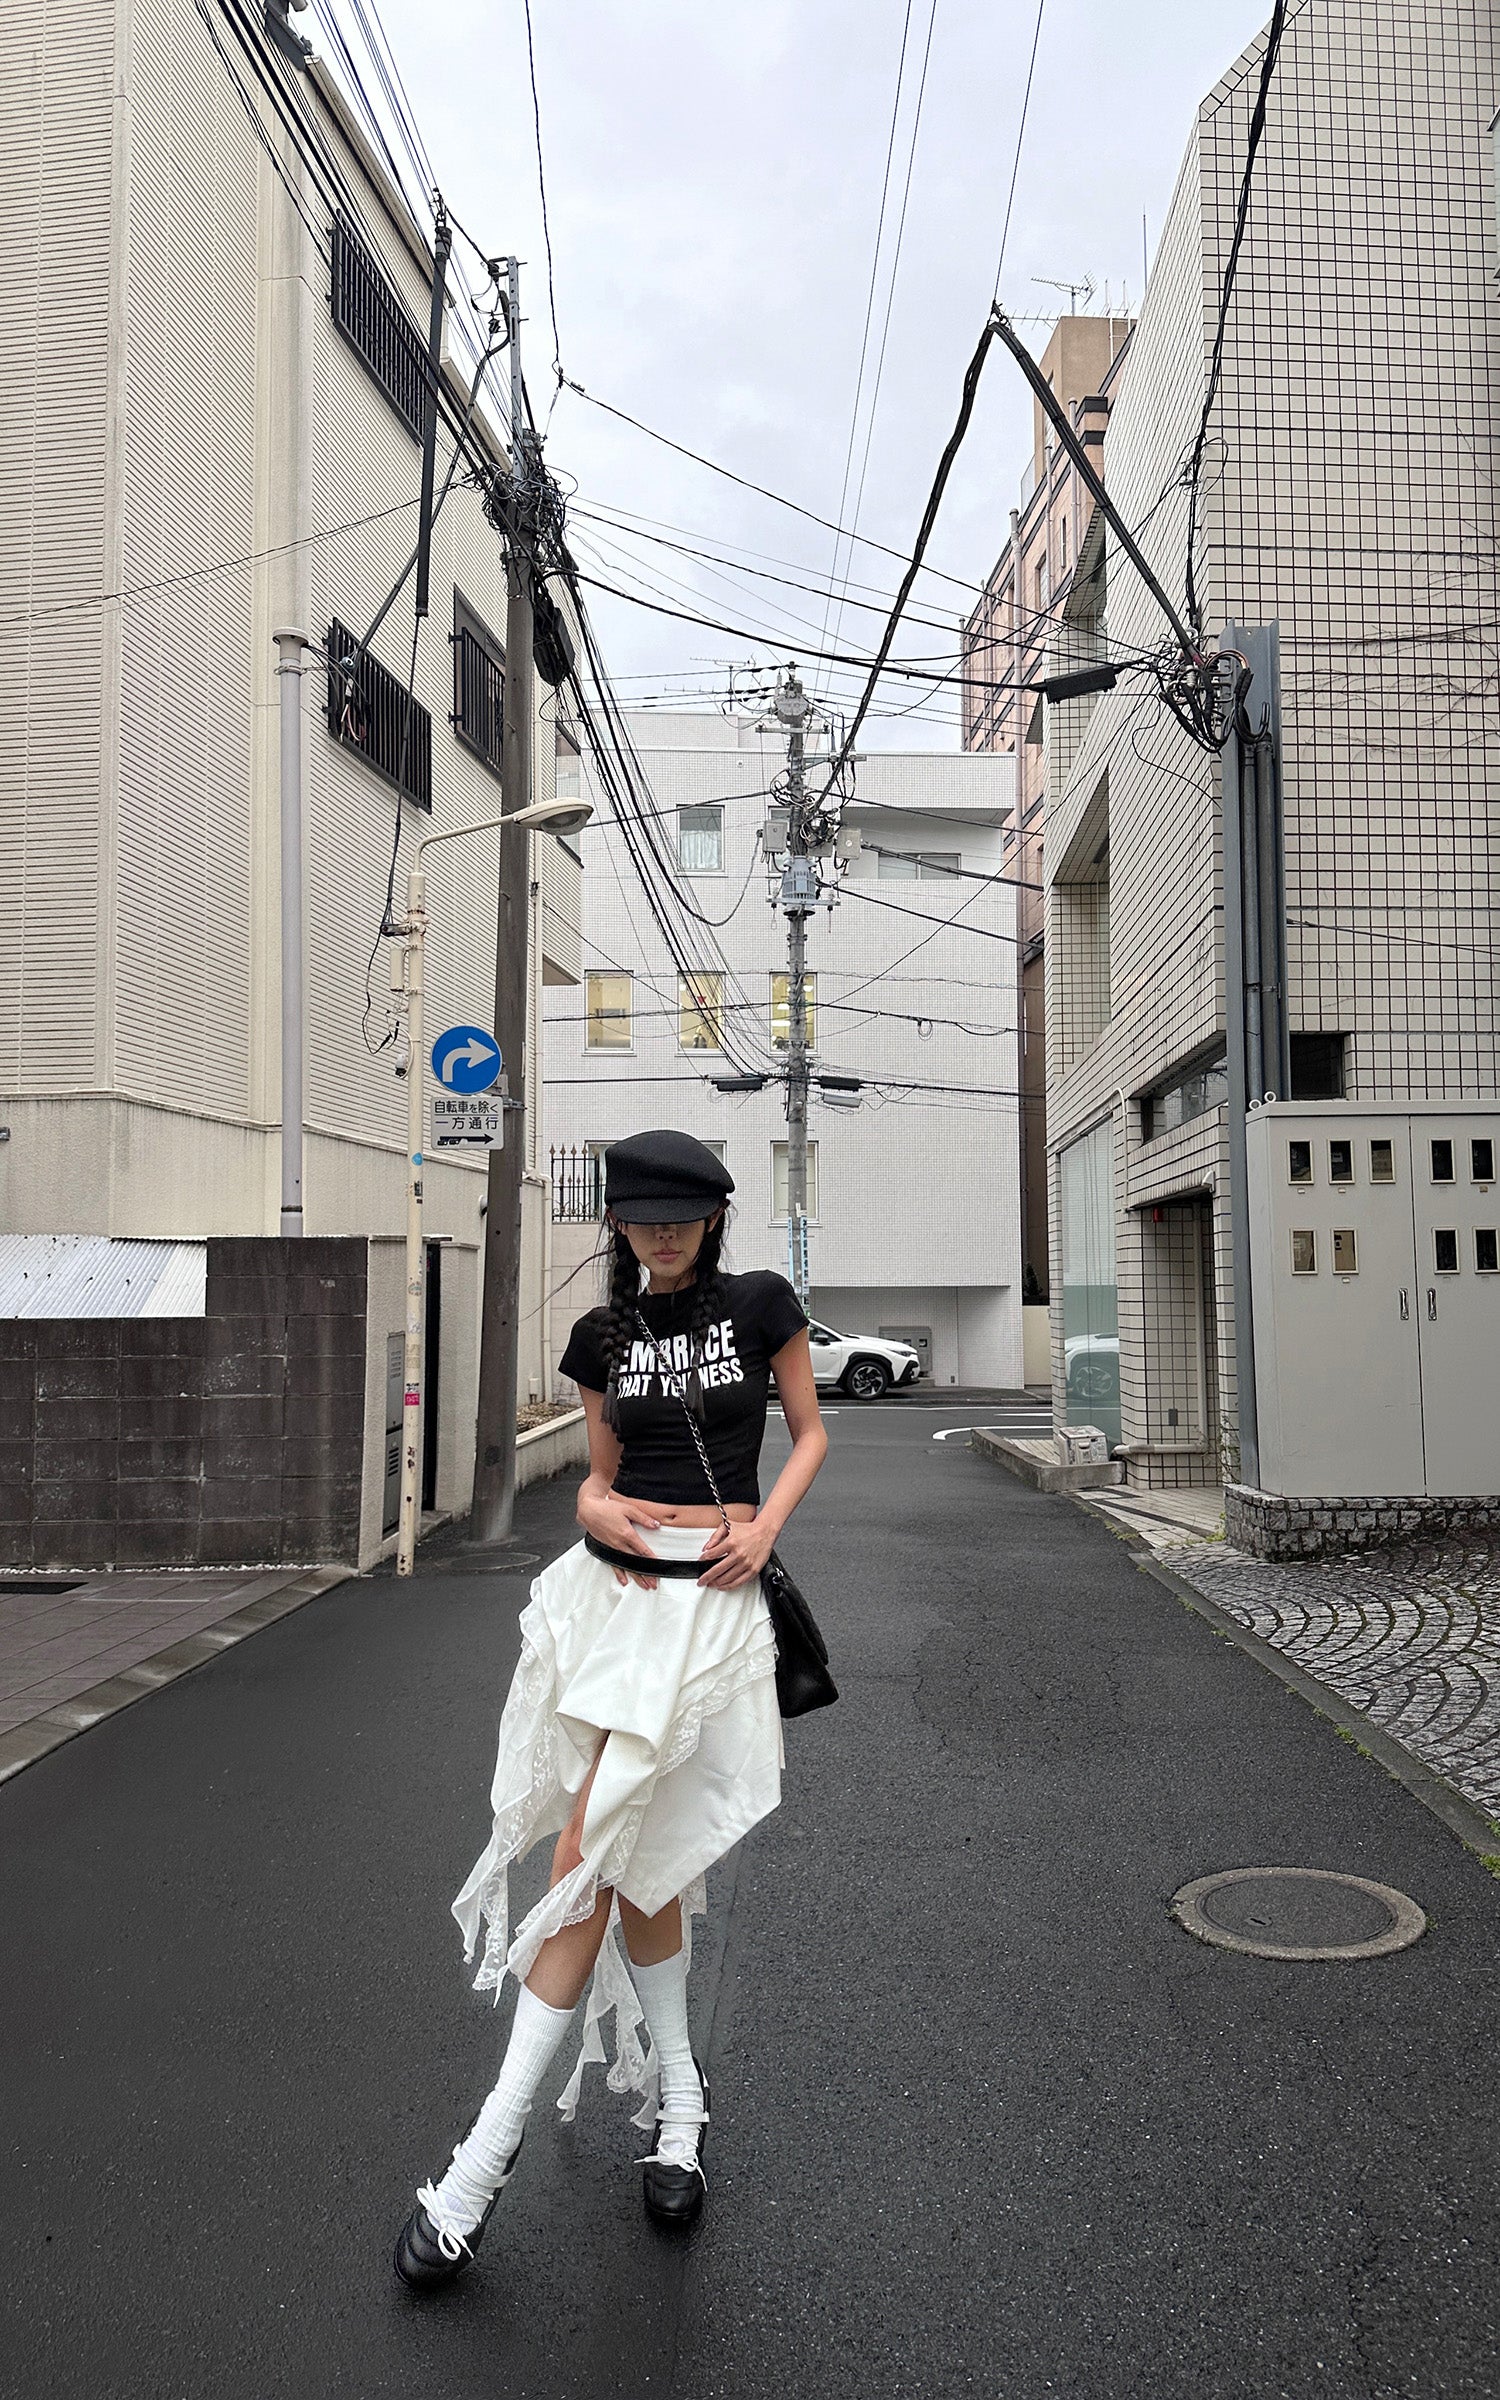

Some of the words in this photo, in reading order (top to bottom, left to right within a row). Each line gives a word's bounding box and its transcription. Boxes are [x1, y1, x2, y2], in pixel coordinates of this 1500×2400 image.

[435, 1100, 498, 1114] 自転車を除く
[435, 1116, 498, 1130] 一方通行
[617, 1374, 653, 1400] HAT
